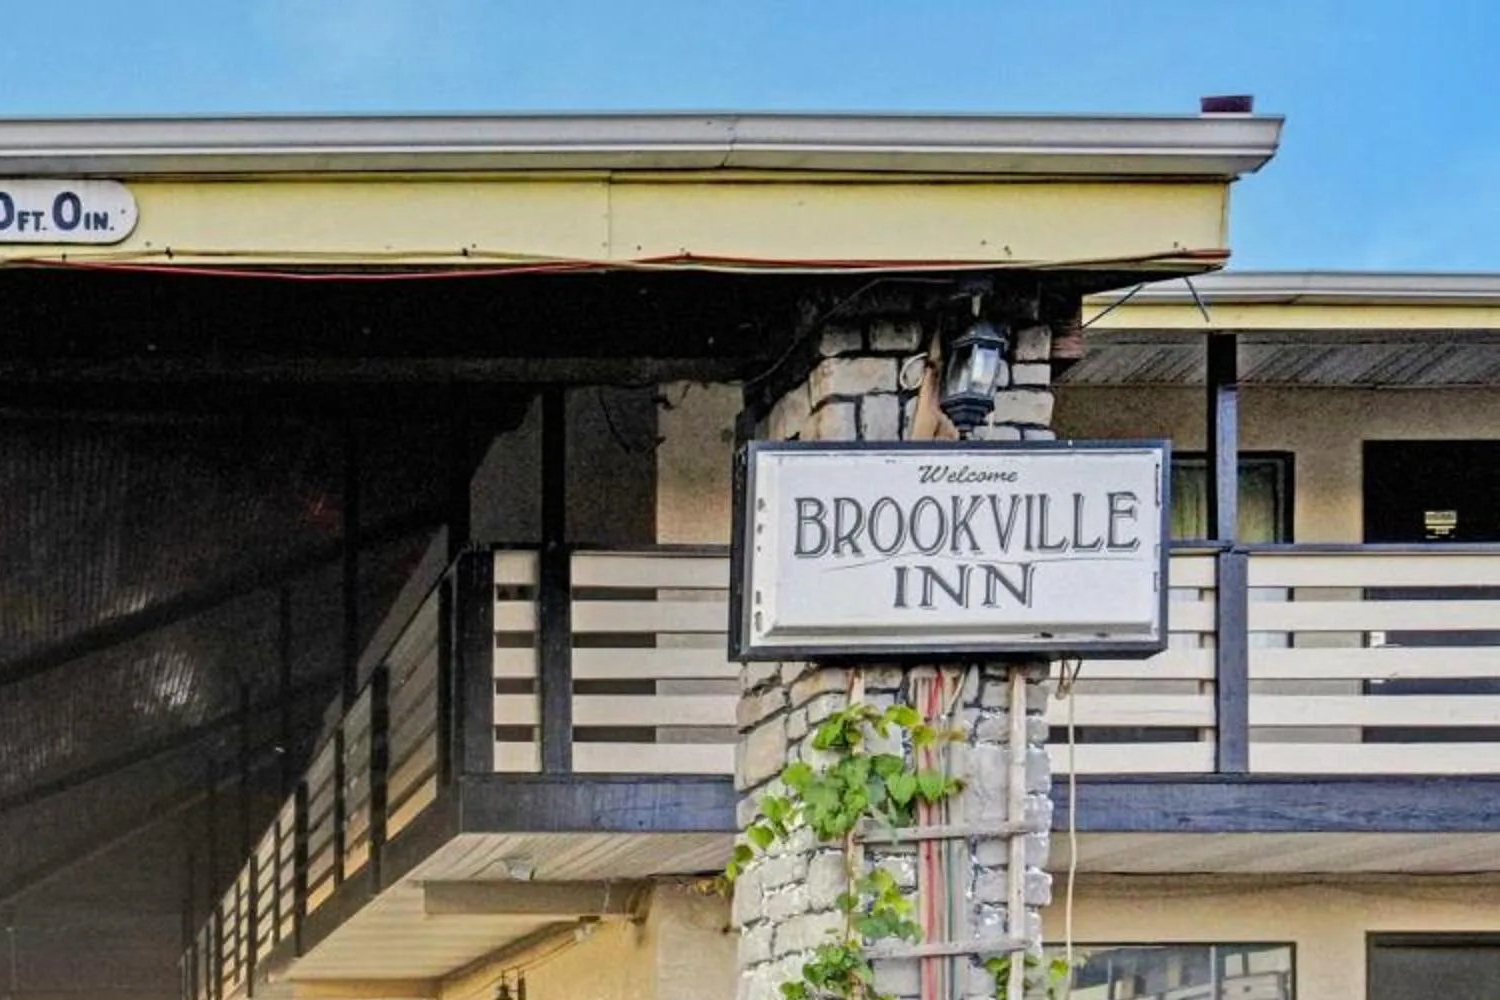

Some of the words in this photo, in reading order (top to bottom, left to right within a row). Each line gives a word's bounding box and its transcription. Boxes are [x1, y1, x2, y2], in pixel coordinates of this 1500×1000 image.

[918, 465, 1018, 484] Welcome
[794, 492, 1142, 558] BROOKVILLE
[893, 563, 1036, 609] INN
